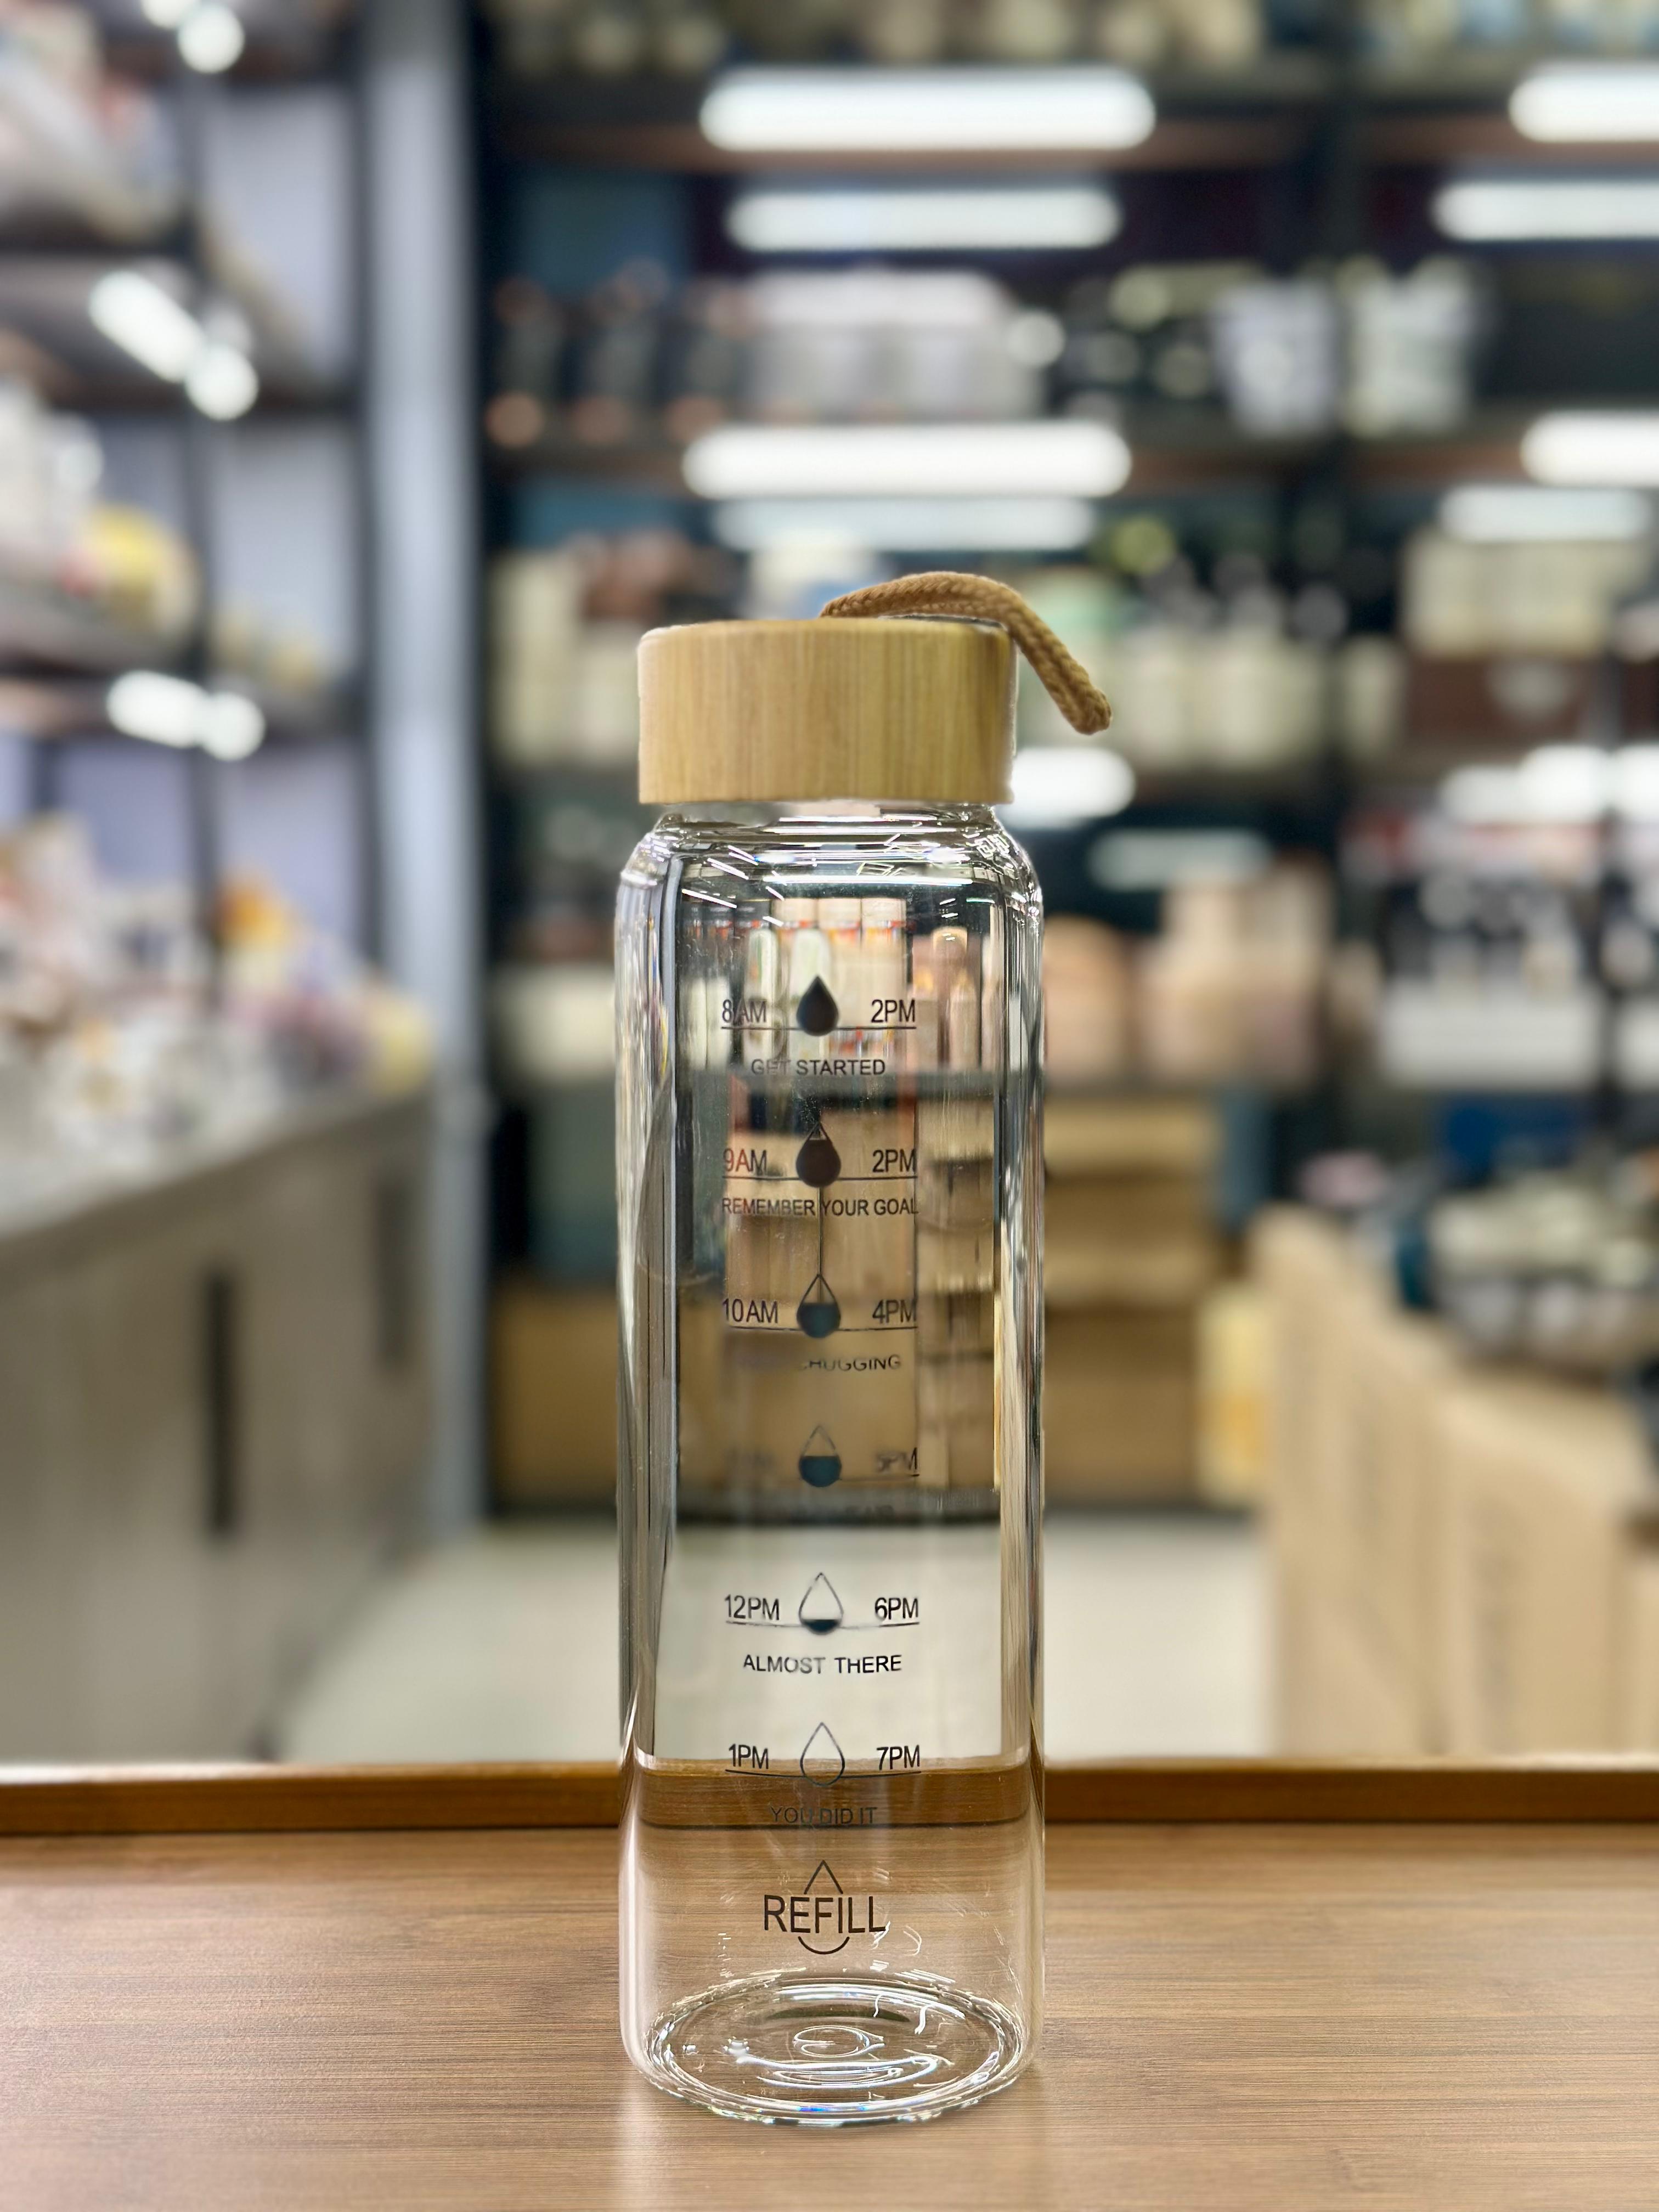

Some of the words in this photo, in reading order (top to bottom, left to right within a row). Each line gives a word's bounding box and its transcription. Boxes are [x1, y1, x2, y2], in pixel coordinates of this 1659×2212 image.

[722, 999, 767, 1023] 8AM
[871, 999, 916, 1023] 2PM
[751, 1059, 791, 1075] GET
[797, 1059, 885, 1075] STARTED
[724, 1148, 767, 1172] 9AM
[872, 1149, 916, 1173] 2PM
[722, 1198, 815, 1216] REMEMBER
[821, 1199, 869, 1216] YOUR
[874, 1198, 918, 1215] GOAL
[723, 1298, 778, 1323] 10AM
[872, 1299, 917, 1324] 4PM
[803, 1354, 901, 1371] HUGGING
[725, 1594, 780, 1620] 12PM
[875, 1597, 918, 1620] 6PM
[743, 1655, 825, 1674] ALMOST
[834, 1655, 902, 1673] THERE
[729, 1743, 769, 1769] 1PM
[877, 1745, 920, 1770] 7PM
[770, 1807, 812, 1824] YOU
[820, 1808, 853, 1825] DID
[859, 1807, 877, 1824] IT
[764, 1894, 886, 1933] REFILL
